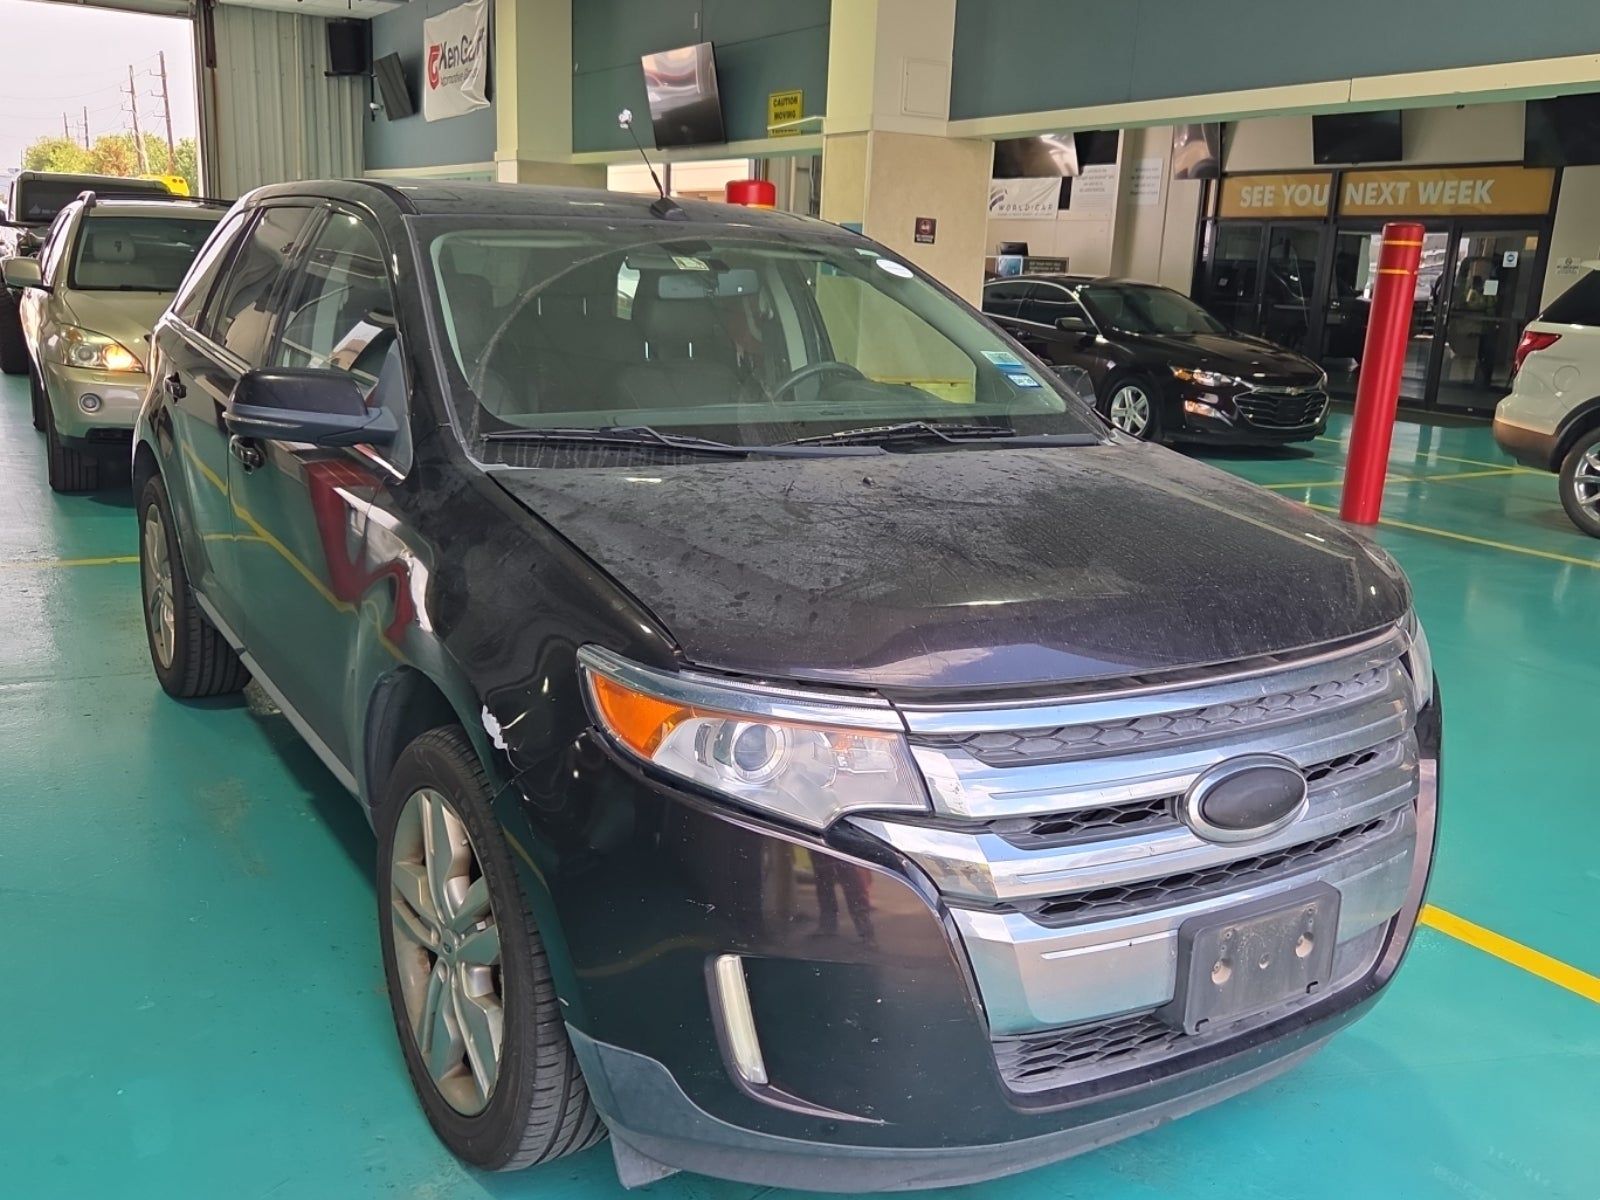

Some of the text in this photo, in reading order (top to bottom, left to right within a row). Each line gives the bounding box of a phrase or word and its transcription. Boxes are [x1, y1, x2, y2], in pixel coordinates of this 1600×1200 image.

[773, 96, 798, 107] CAUTION
[774, 110, 796, 120] MOVING
[1240, 179, 1496, 208] SEE YOU NEXT WEEK
